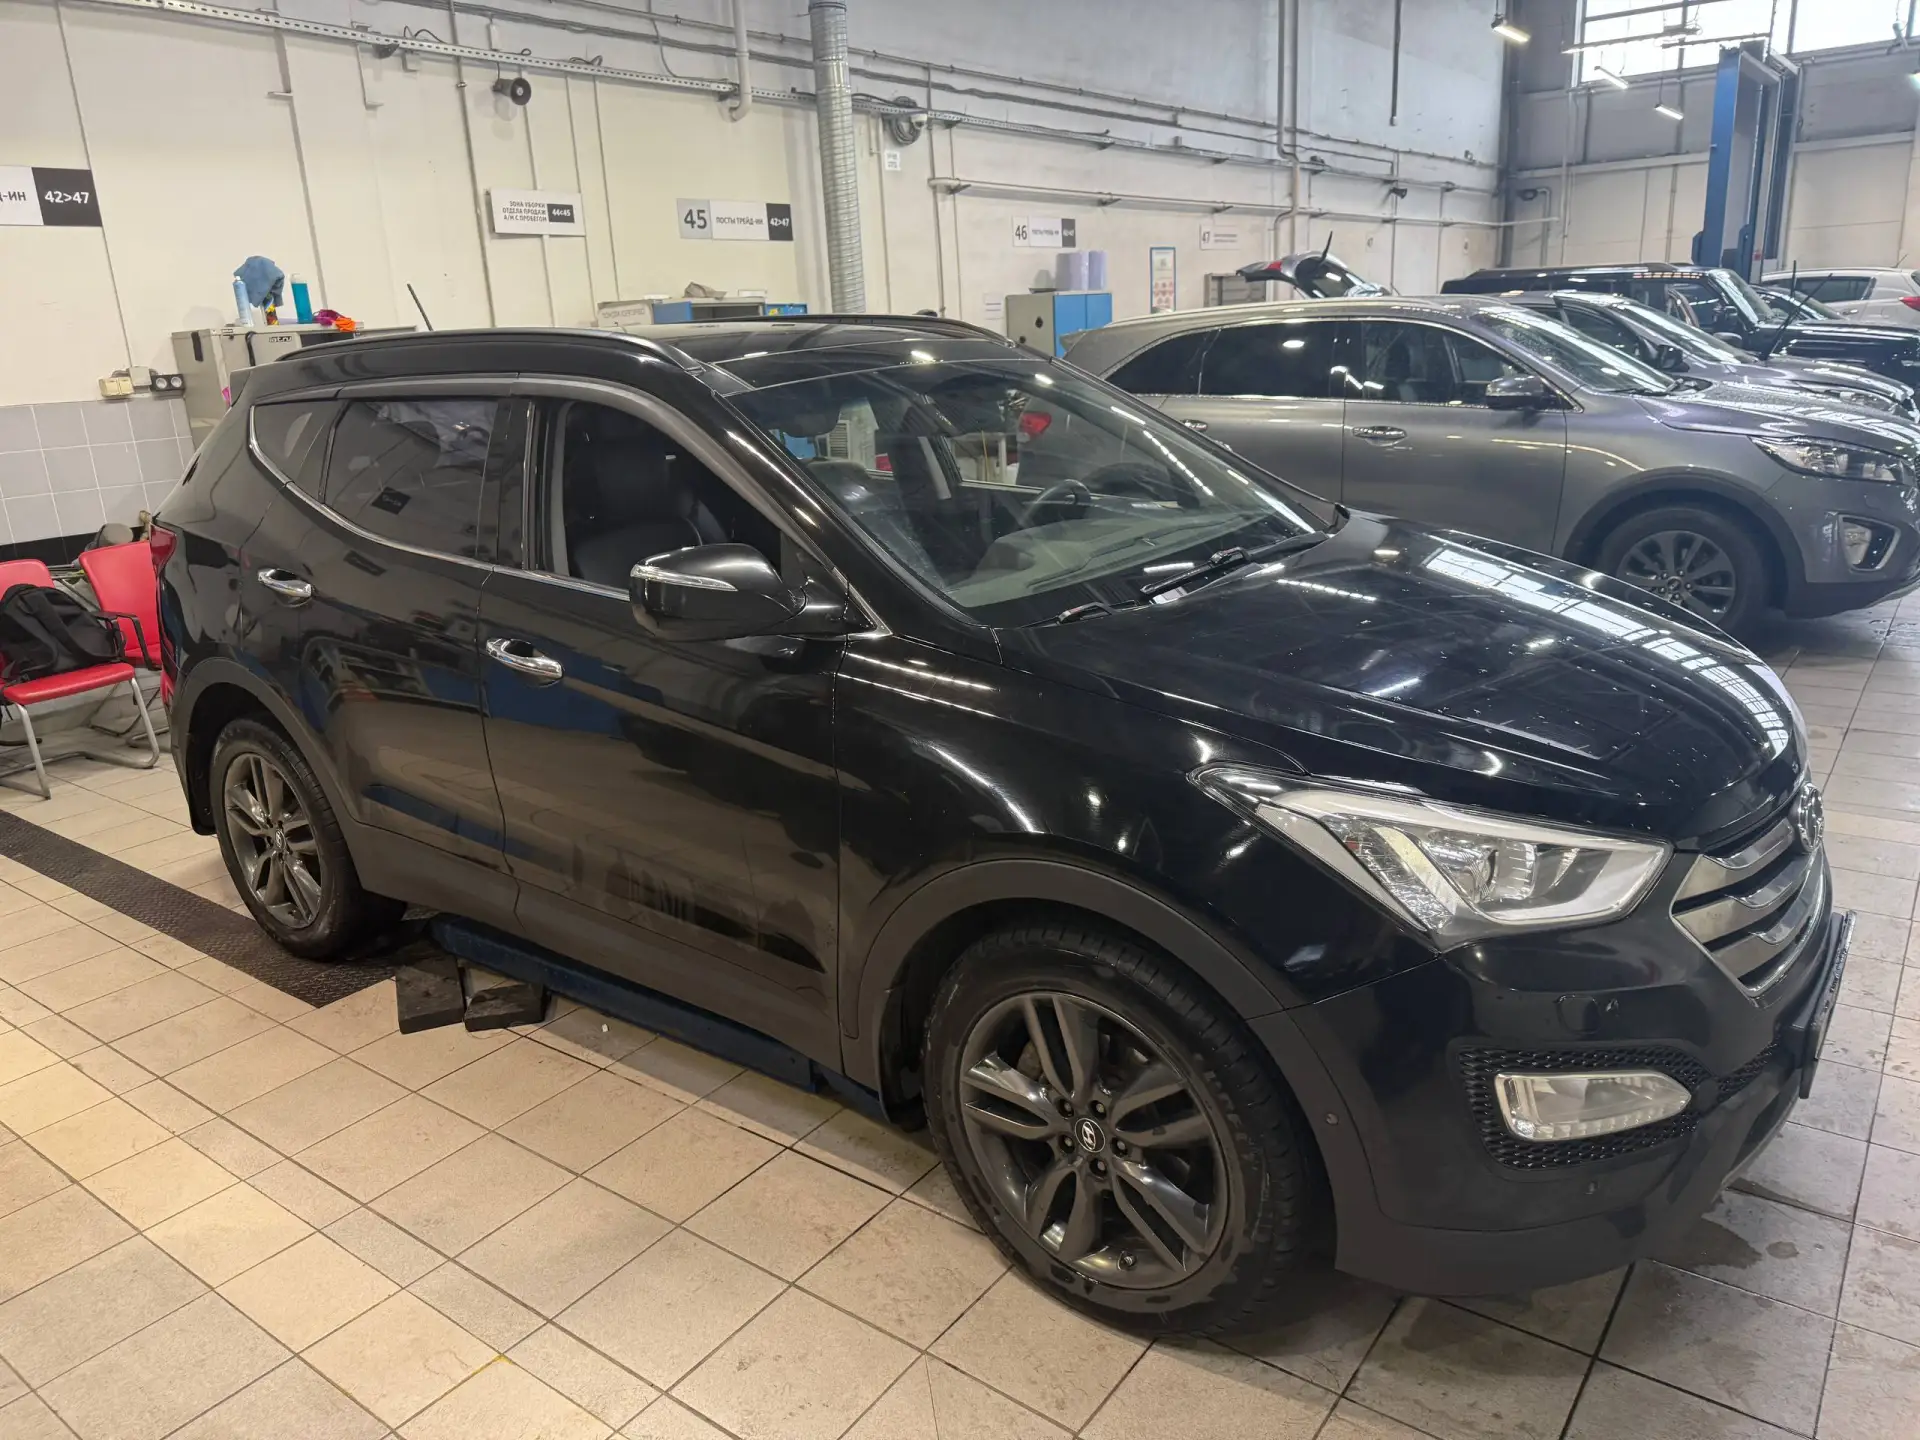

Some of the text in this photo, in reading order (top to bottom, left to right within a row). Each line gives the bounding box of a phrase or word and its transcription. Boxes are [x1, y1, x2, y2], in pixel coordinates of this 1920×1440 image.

[0, 190, 27, 202] -ИН
[44, 190, 90, 204] 42>47
[683, 208, 708, 230] 45
[715, 216, 736, 225] ПОСТЫ
[1014, 224, 1028, 241] 46
